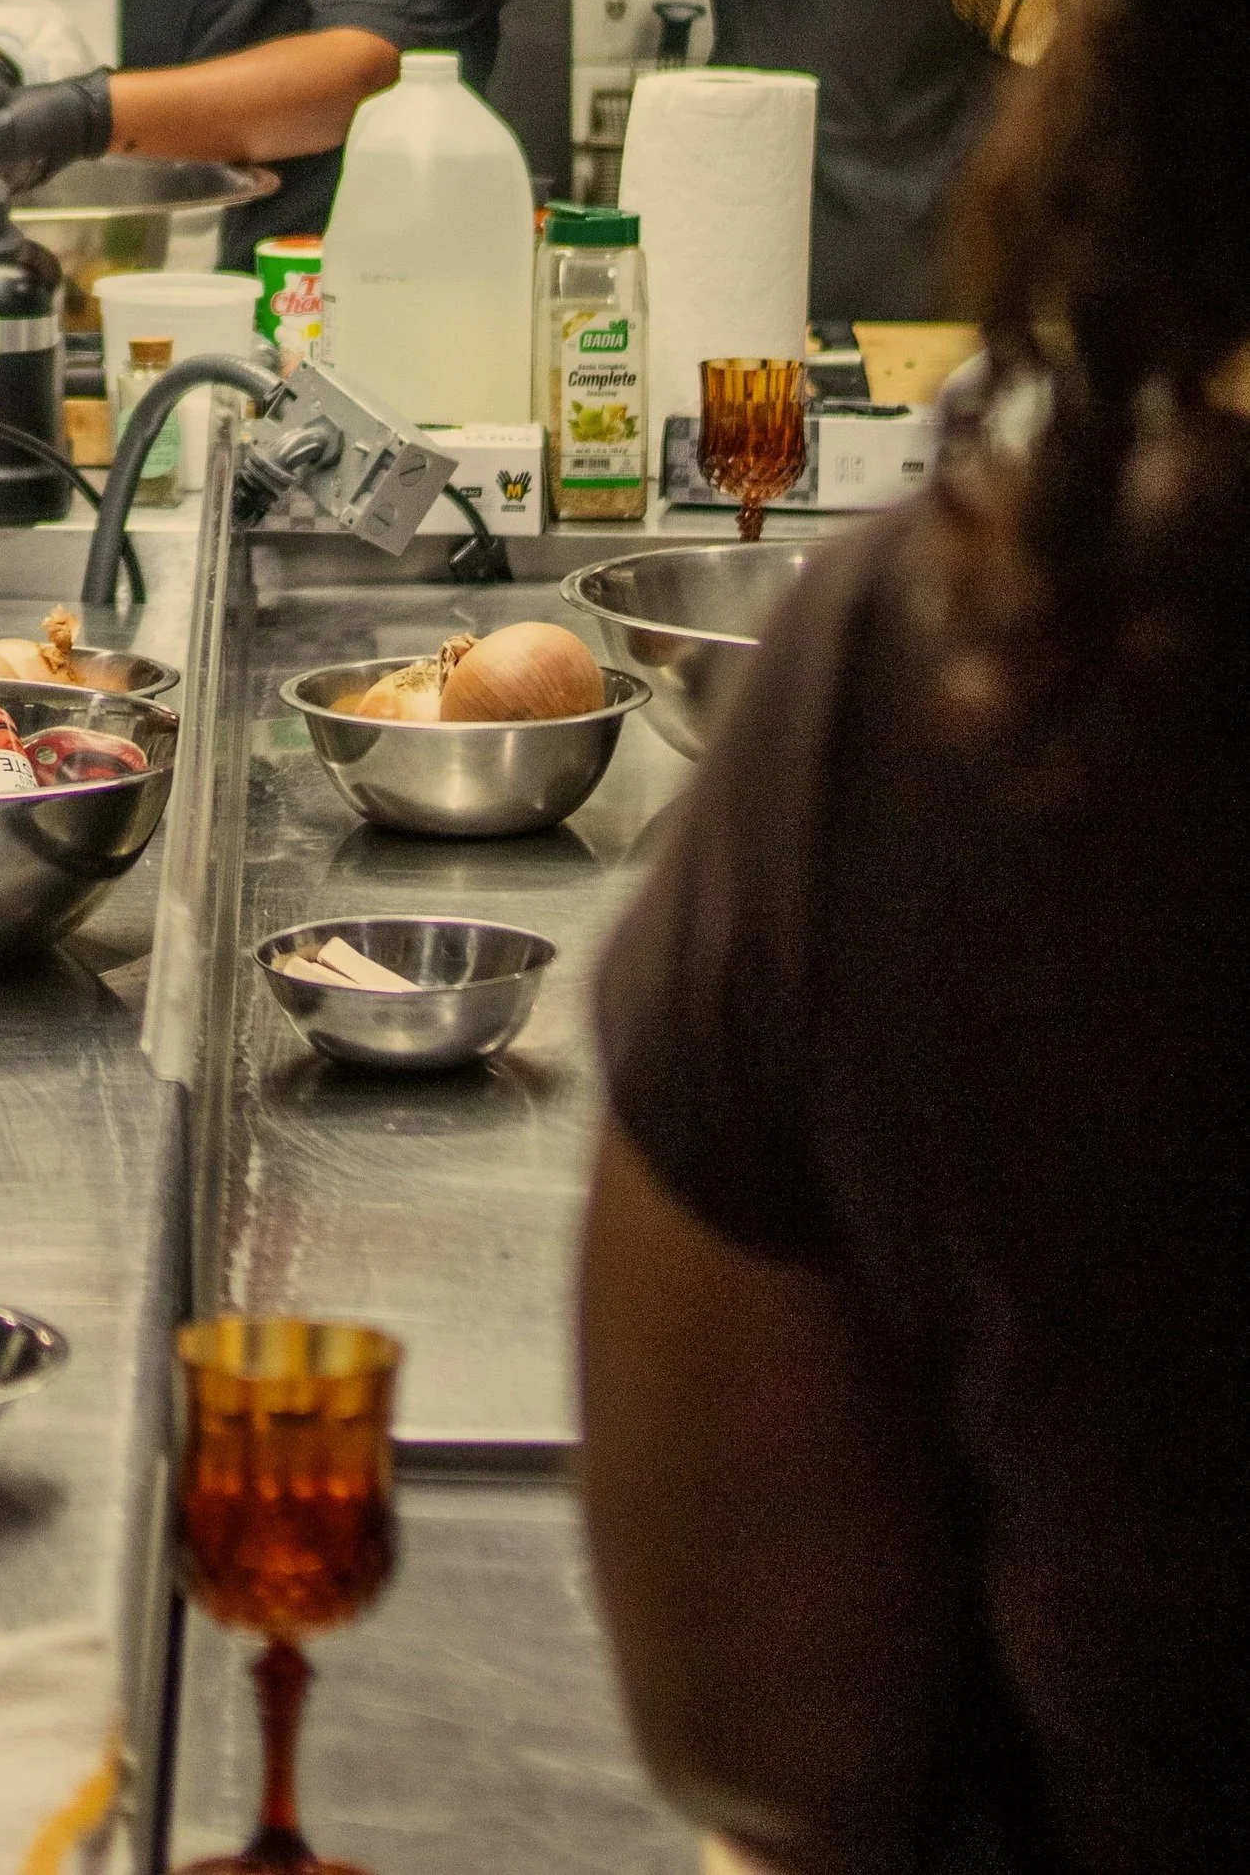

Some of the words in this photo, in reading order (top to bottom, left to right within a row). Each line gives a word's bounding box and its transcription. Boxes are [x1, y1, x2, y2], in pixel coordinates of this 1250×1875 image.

[582, 333, 624, 348] BADIA
[567, 370, 637, 391] Complete
[506, 483, 522, 498] M
[0, 757, 33, 780] STE
